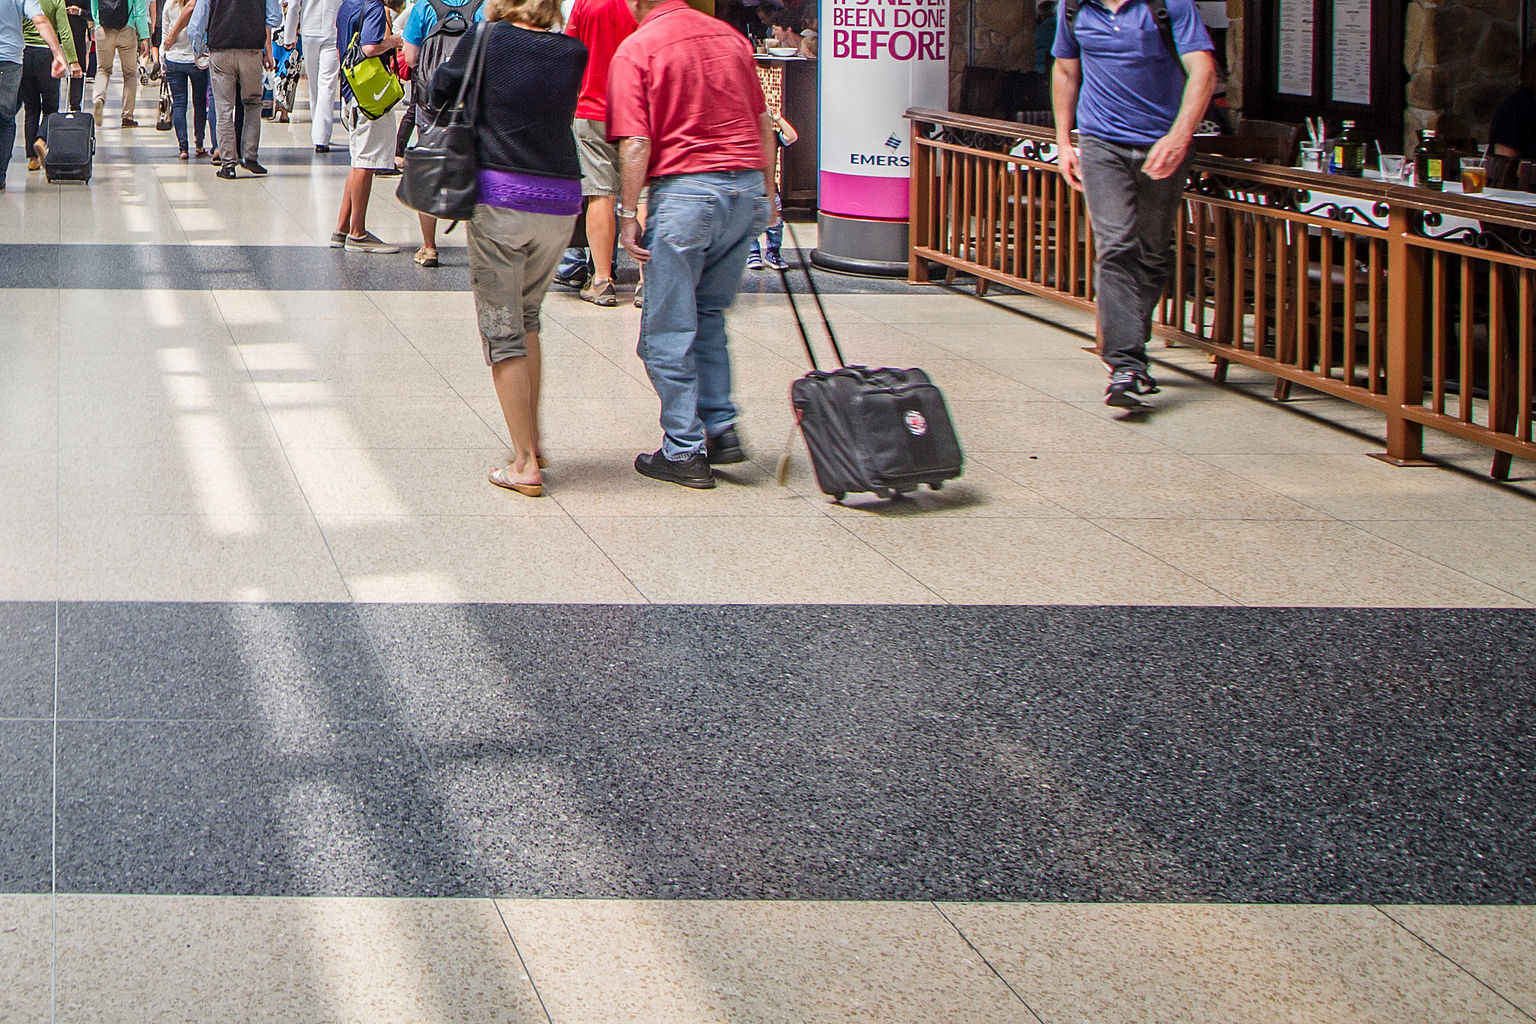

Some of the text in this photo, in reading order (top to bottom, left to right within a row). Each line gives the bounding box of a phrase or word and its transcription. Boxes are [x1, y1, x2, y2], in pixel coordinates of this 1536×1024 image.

[833, 7, 946, 28] BEEN DONE
[833, 29, 946, 61] BEFORE
[850, 153, 910, 167] EMERS
